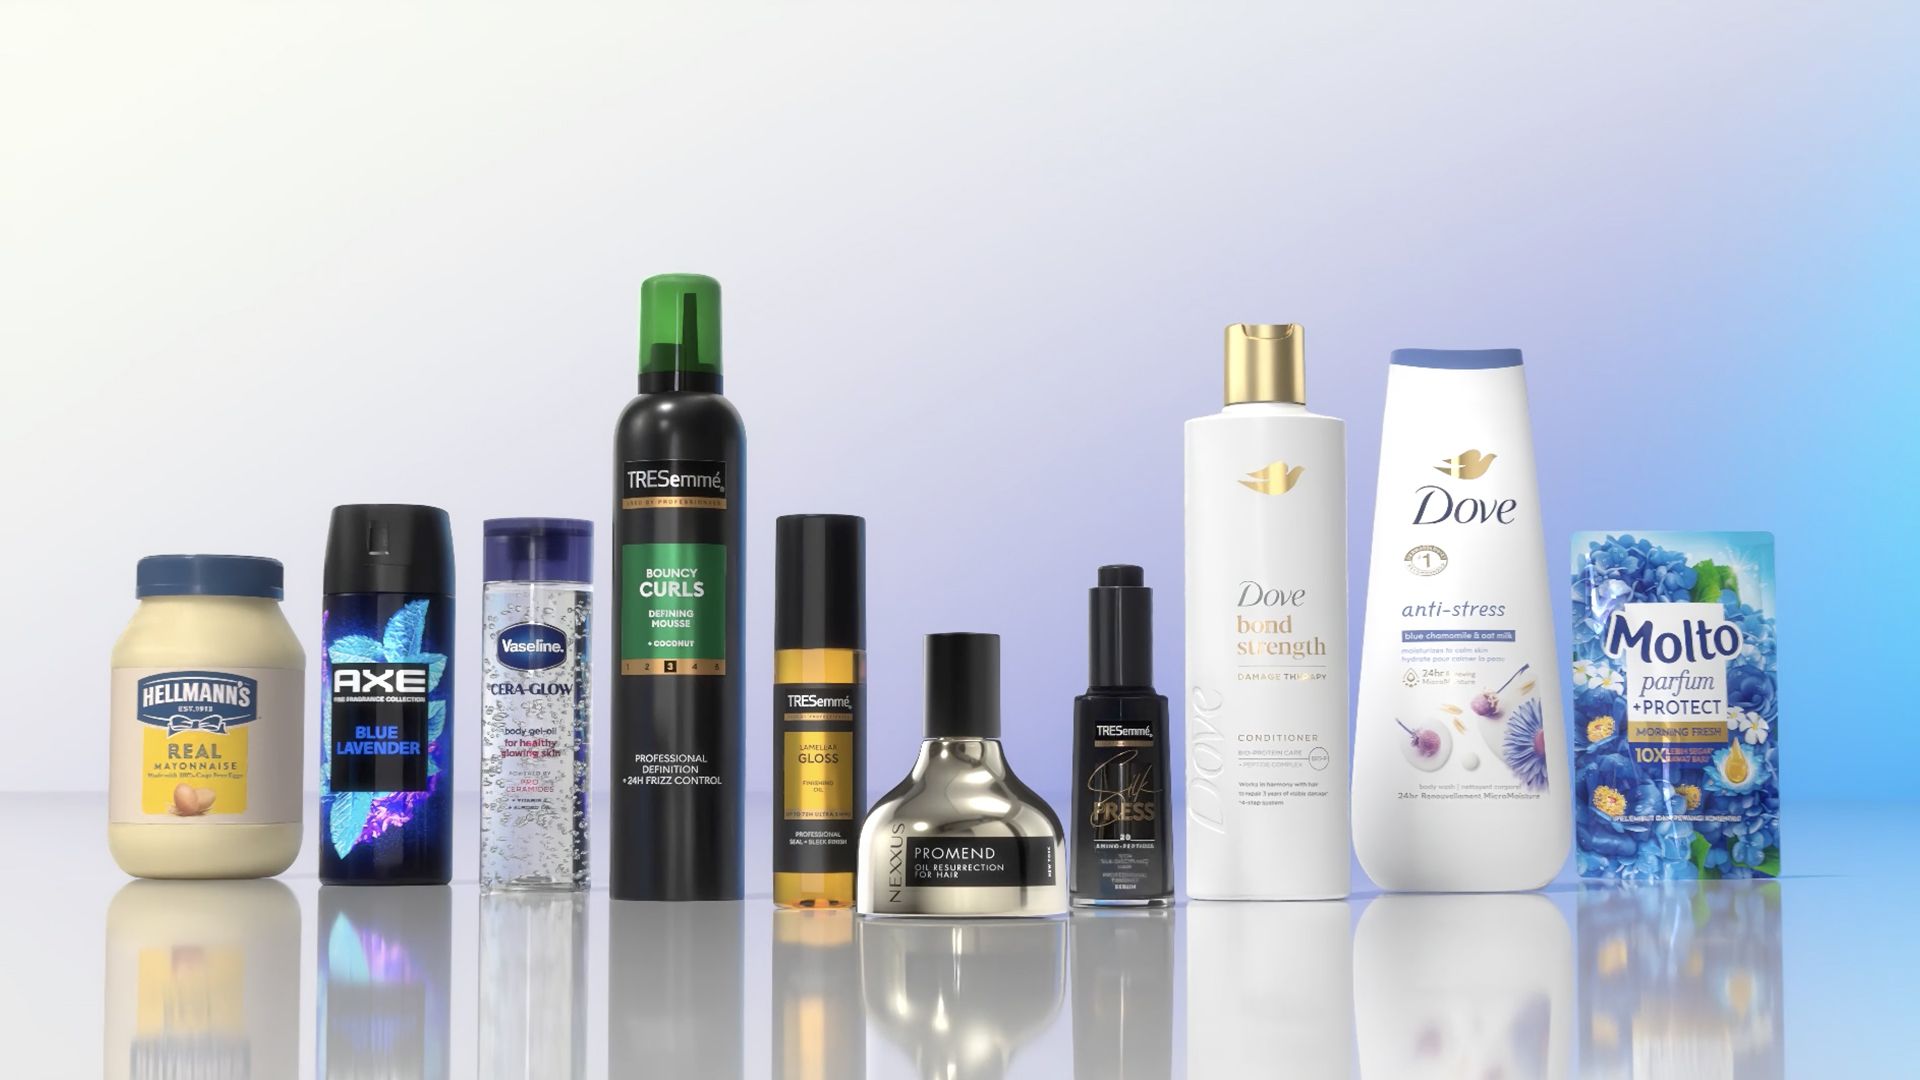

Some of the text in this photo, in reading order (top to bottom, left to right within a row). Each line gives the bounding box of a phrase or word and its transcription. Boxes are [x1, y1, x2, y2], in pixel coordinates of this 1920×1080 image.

[627, 470, 721, 488] TRESemmé
[1412, 485, 1517, 525] Dove
[646, 568, 698, 578] BOUNCY
[640, 581, 704, 598] CURLS
[1237, 580, 1306, 607] Dove
[648, 610, 694, 618] DEFINING
[1402, 600, 1506, 618] anti-stress
[652, 620, 690, 628] MOUSSE
[1236, 614, 1292, 634] bond
[1404, 632, 1424, 640] blue
[1426, 632, 1472, 640] chamomile
[1482, 632, 1494, 640] oat
[1609, 614, 1739, 664] Molto
[1237, 636, 1327, 660] strength
[666, 662, 674, 670] 3
[334, 670, 426, 692] AXE
[1639, 670, 1715, 697] parfum
[142, 681, 250, 708] HELLMANN'S
[490, 683, 573, 695] CERA-GLOW
[788, 694, 850, 708] TRESemmé
[1633, 700, 1721, 715] +PROTECT
[355, 726, 398, 739] BLUE
[504, 728, 526, 736] body
[1096, 726, 1150, 736] TRESemmé
[1636, 728, 1722, 736] MORNING FRESH
[520, 739, 558, 748] healthy
[1238, 734, 1318, 742] CONDITIONER
[168, 744, 222, 759] REAL
[336, 742, 420, 754] LAVENDER
[500, 750, 540, 758] glowing
[635, 754, 708, 763] PROFESSIONAL
[798, 754, 839, 764] GLOSS
[1635, 748, 1666, 763] 10X
[154, 762, 238, 770] MAYONNAISE
[642, 765, 699, 774] DEFINITION
[646, 776, 672, 785] FRIZZ
[674, 776, 722, 785] CONTROL
[1094, 802, 1154, 821] PRESS
[915, 847, 996, 860] PROMEND
[889, 823, 906, 903] NEXXUS
[914, 864, 1004, 872] OIL RESURRECTION
[914, 870, 958, 878] FOR HAIR
